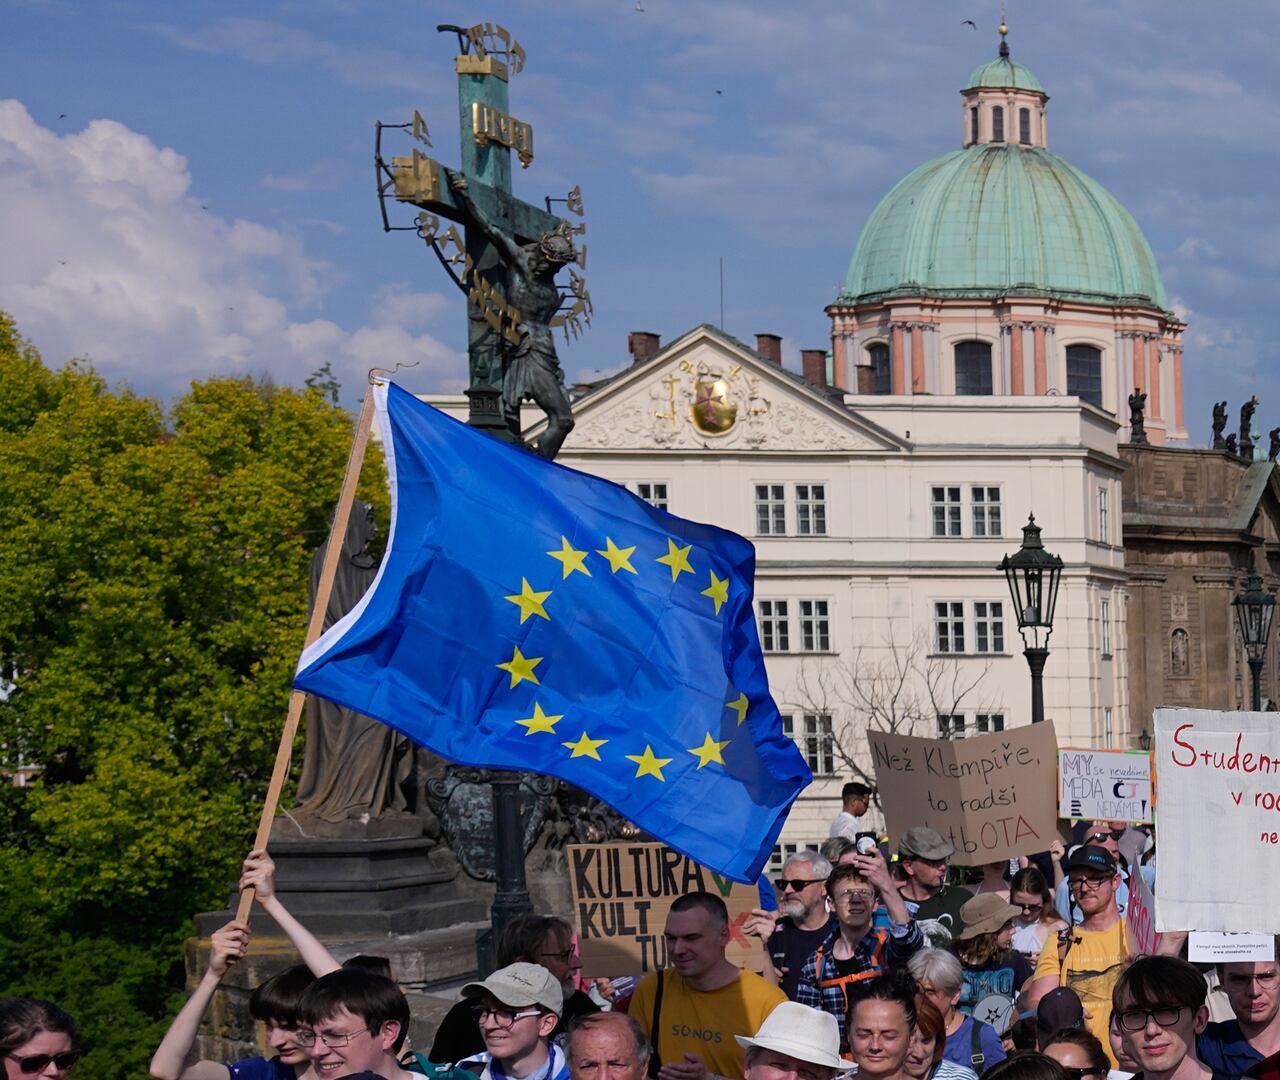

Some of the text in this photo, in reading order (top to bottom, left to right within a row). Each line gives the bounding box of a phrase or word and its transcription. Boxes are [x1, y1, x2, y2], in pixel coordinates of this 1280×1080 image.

[874, 742, 914, 771] Než
[1063, 753, 1093, 775] MY
[927, 785, 1017, 812] to radši
[1231, 791, 1243, 806] v
[573, 847, 706, 899] KULTURA
[578, 901, 651, 940] KULT
[671, 1024, 723, 1044] SONOS
